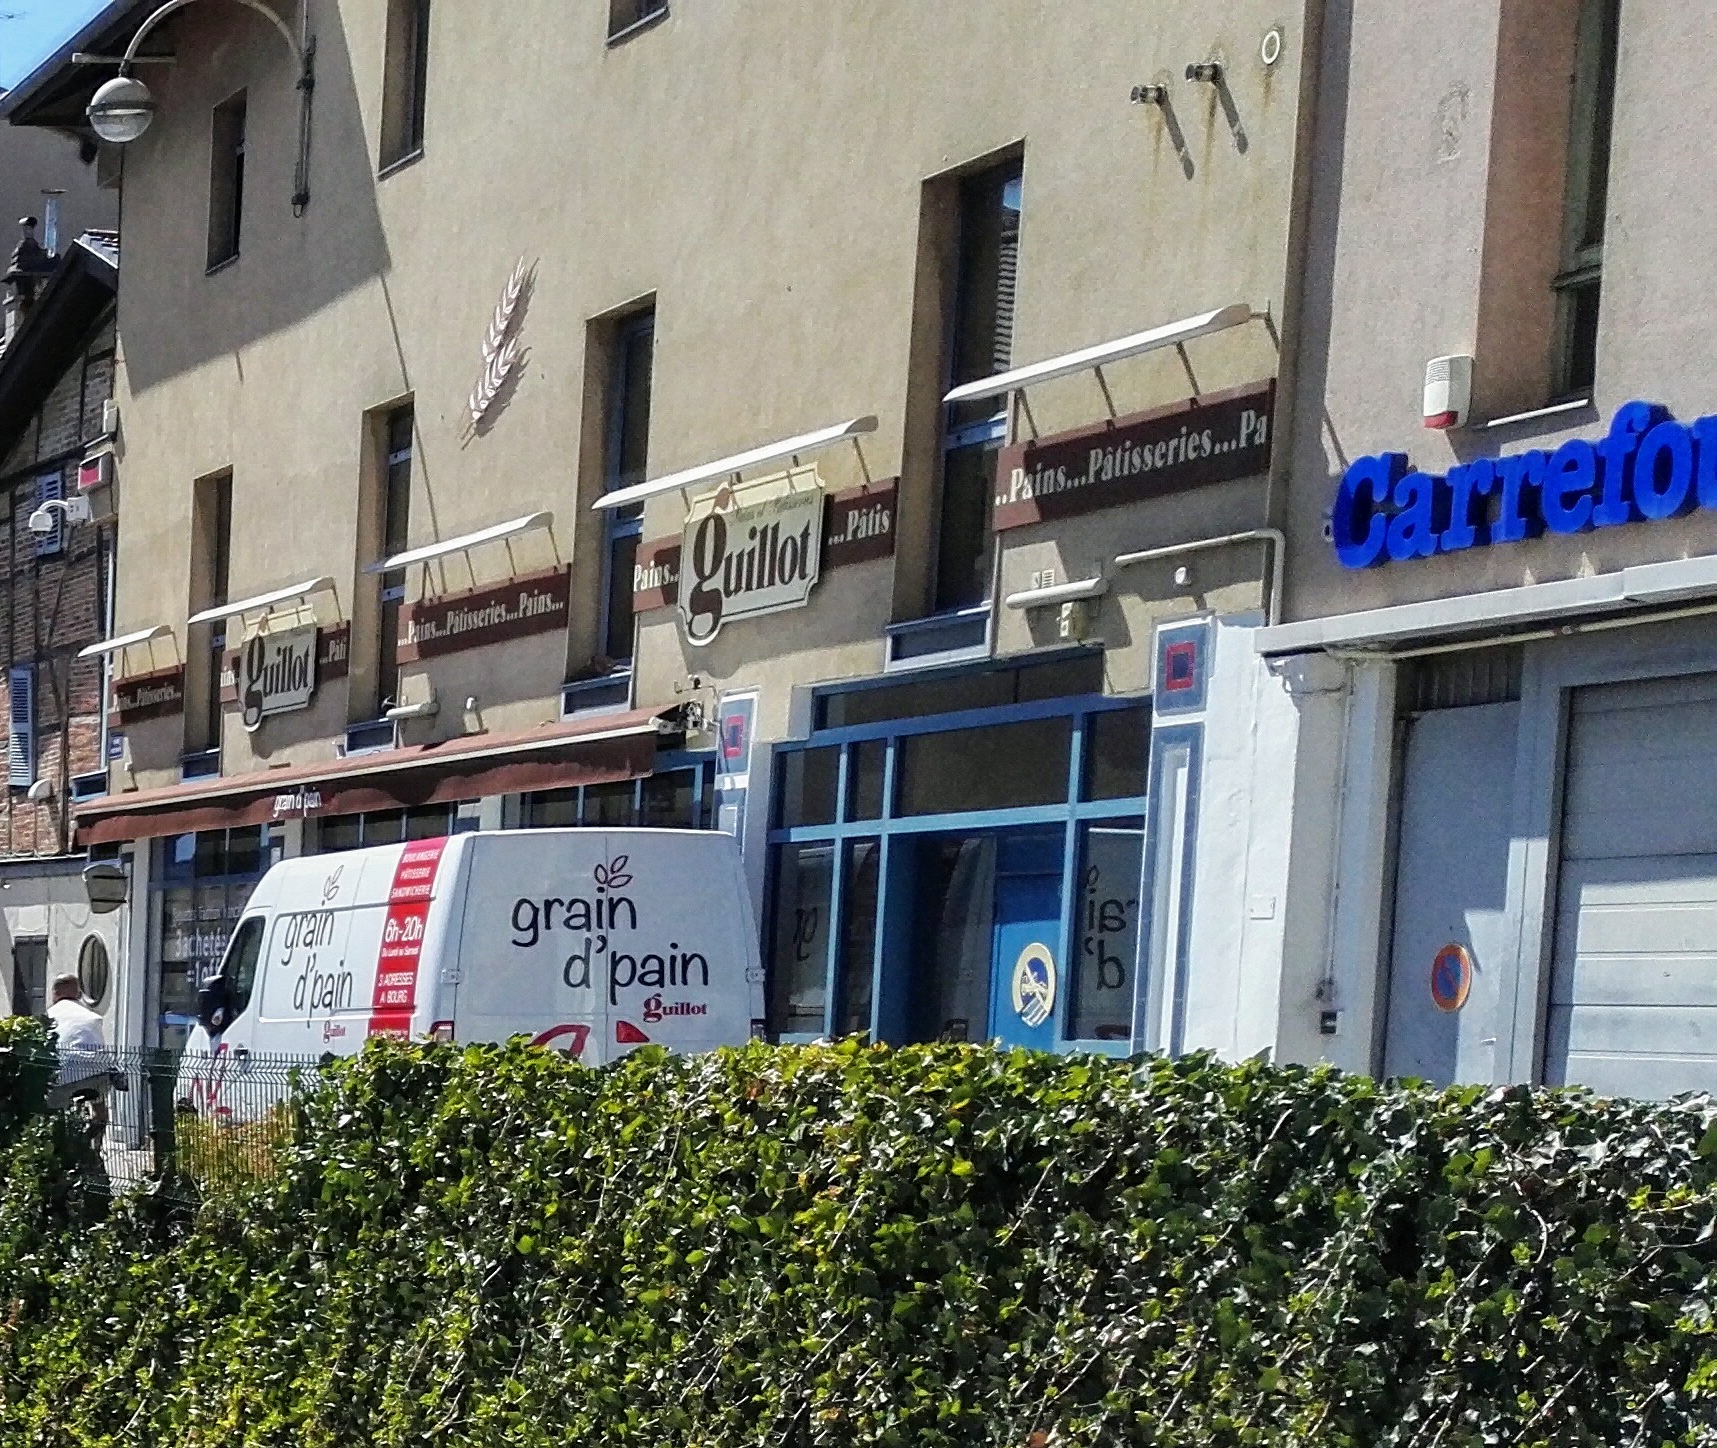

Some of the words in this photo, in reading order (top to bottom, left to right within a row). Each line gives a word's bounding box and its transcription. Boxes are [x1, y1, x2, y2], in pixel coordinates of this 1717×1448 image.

[689, 490, 812, 640] guillot
[244, 620, 312, 726] guillot
[280, 900, 336, 967] grain
[385, 916, 423, 943] 6h-20h
[511, 886, 637, 948] grain
[293, 953, 353, 1029] d'pain
[563, 934, 709, 1006] d'pain
[643, 993, 708, 1023] guillot
